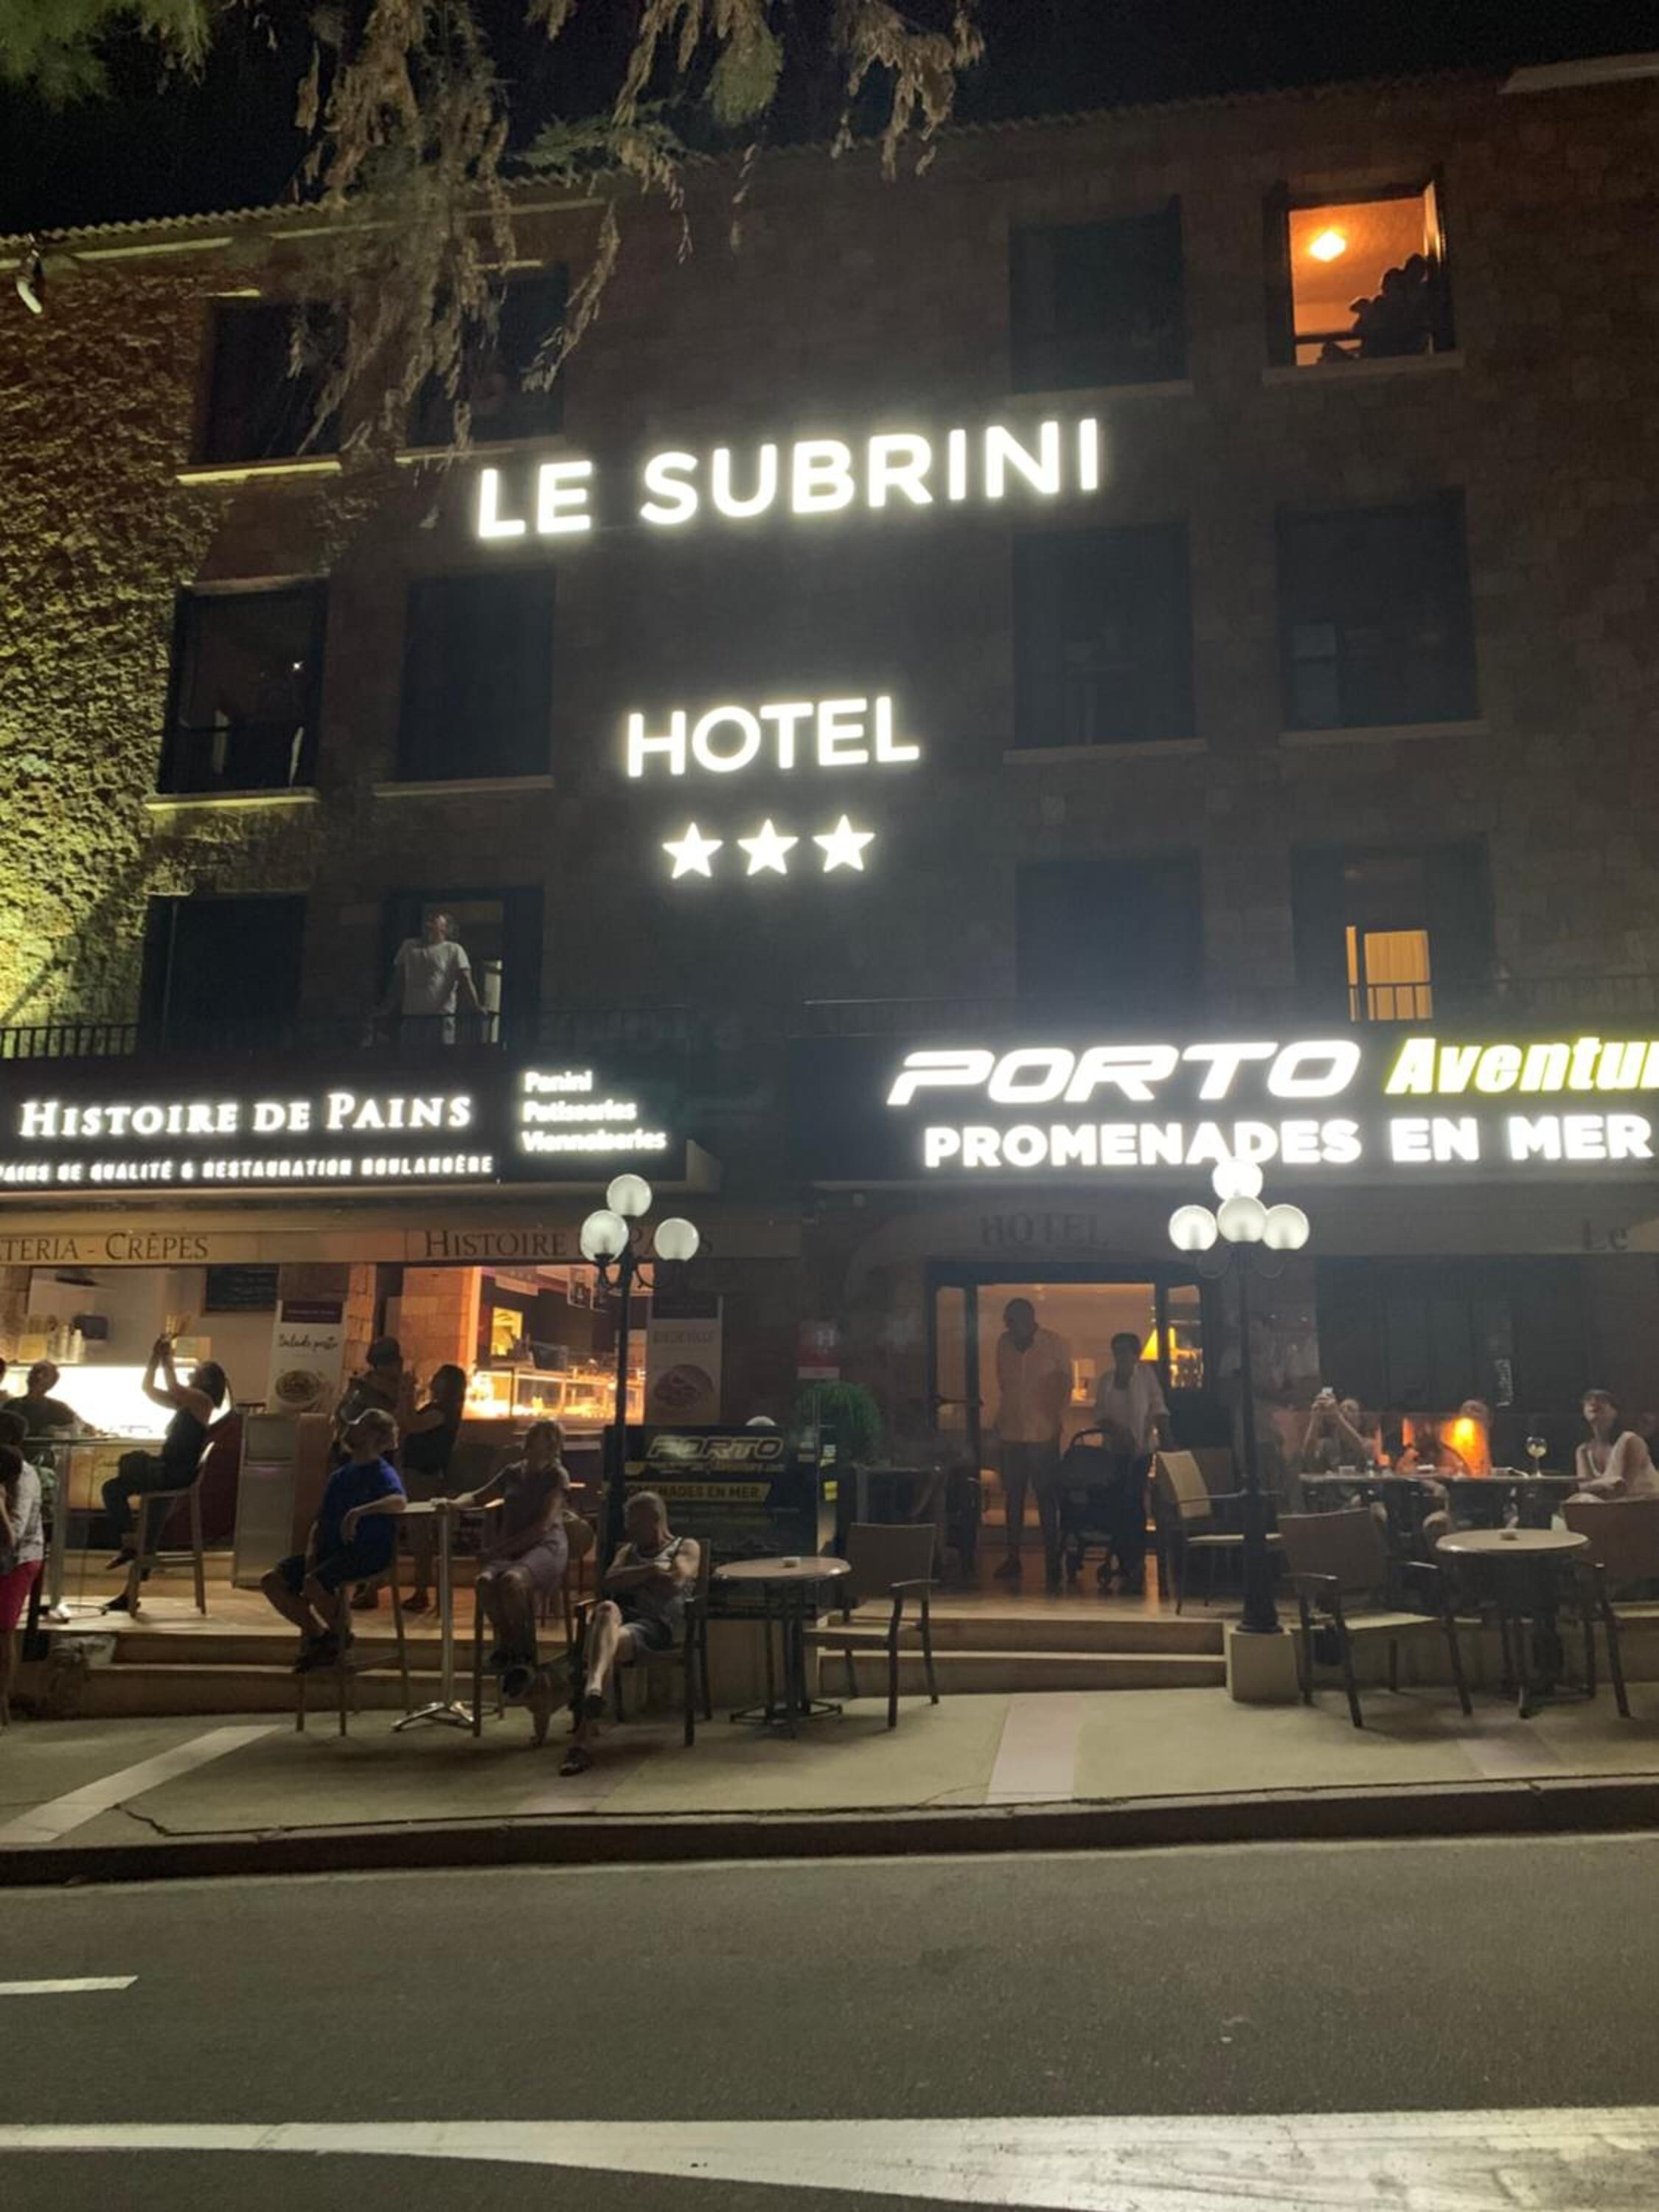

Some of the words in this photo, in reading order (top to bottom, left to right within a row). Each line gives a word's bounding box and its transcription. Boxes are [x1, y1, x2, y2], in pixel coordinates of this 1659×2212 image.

[477, 460, 593, 540] LE
[639, 418, 1099, 526] SUBRINI
[627, 695, 920, 778] HOTEL
[886, 1039, 1361, 1106] PORTO
[253, 1102, 310, 1132] DE
[924, 1118, 1363, 1168] PROMENADES
[1388, 1116, 1480, 1163] EN
[1506, 1113, 1655, 1161] MER
[979, 1211, 1109, 1248] HOTEL
[646, 1435, 785, 1460] PORTO
